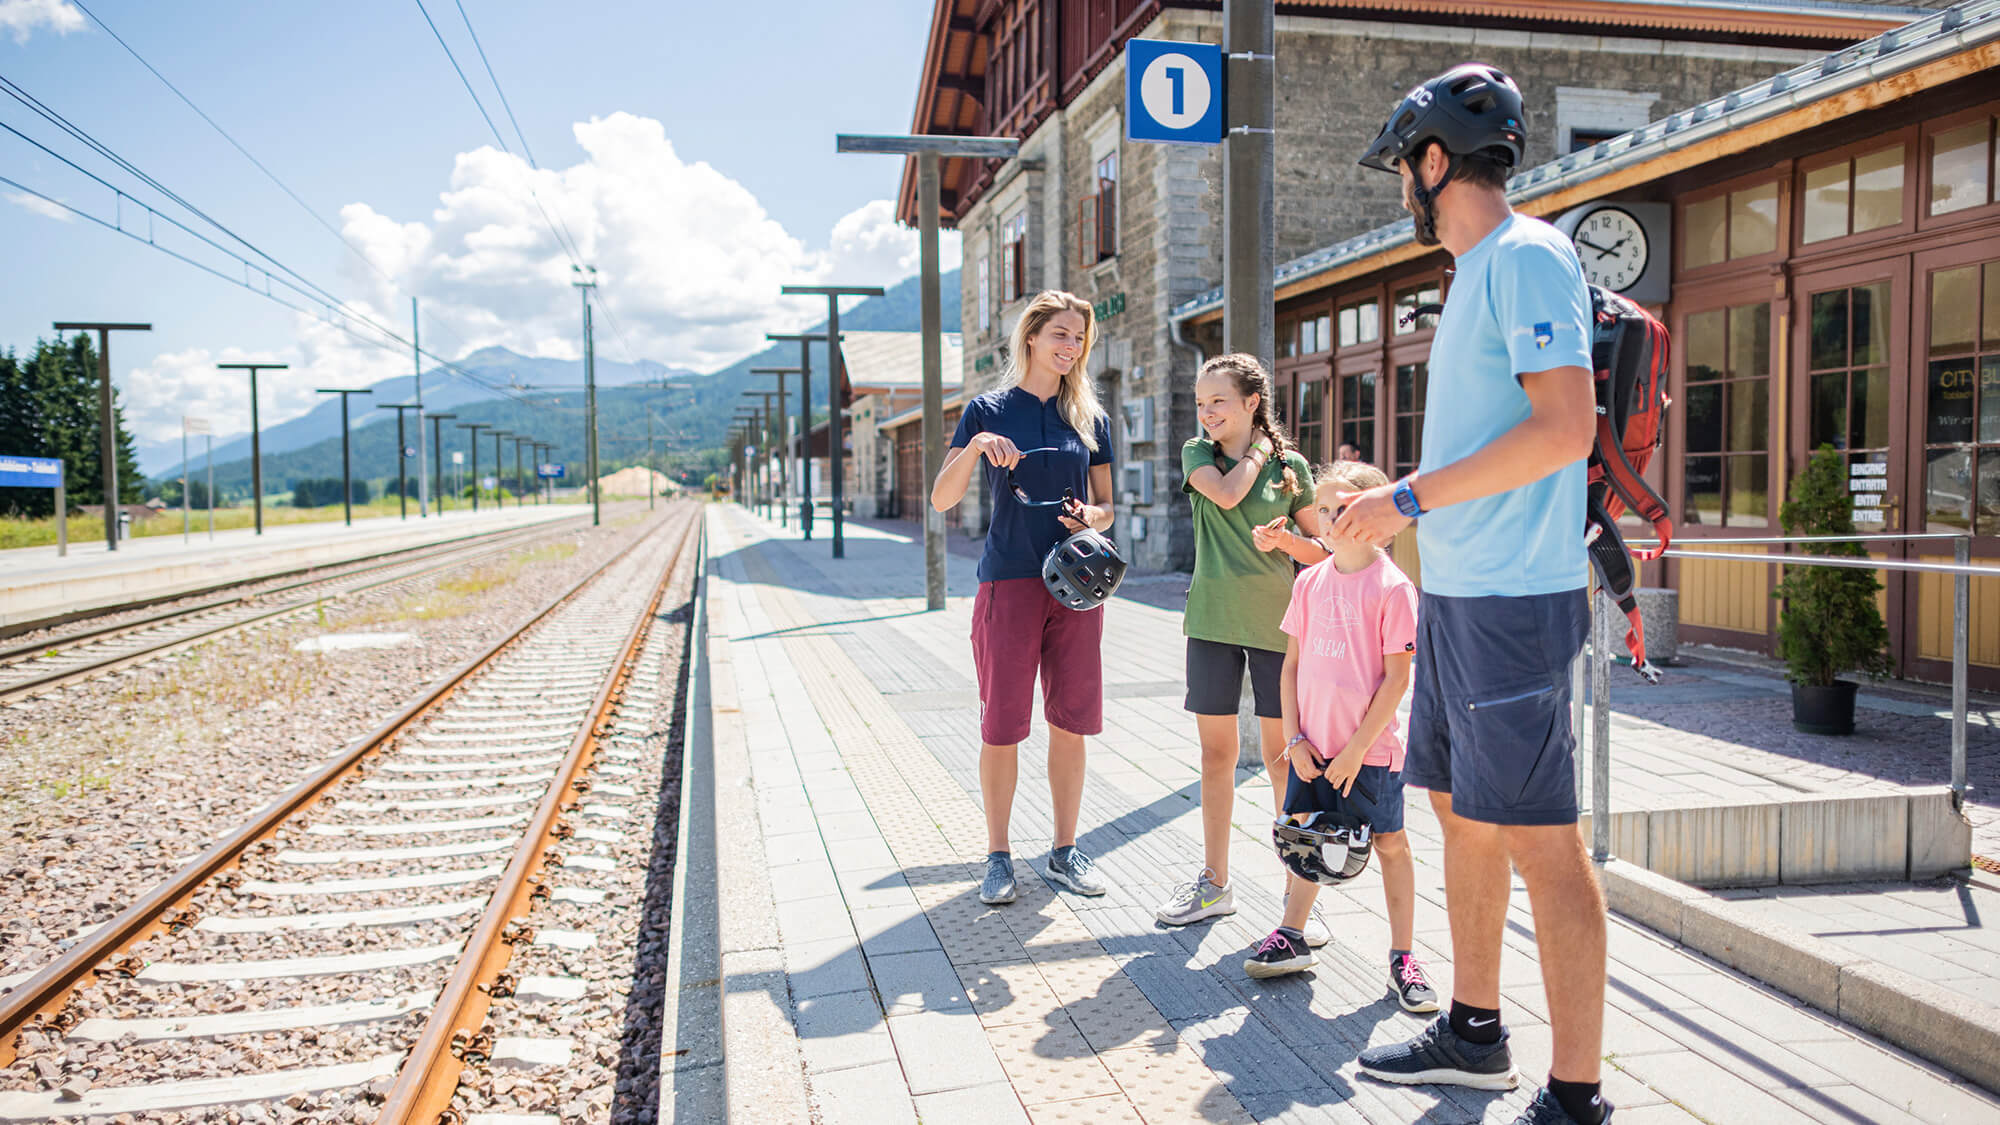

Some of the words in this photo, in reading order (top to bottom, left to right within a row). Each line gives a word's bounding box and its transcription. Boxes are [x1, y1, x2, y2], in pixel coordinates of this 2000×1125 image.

[1166, 67, 1184, 115] 1
[1591, 220, 1597, 231] 11
[1602, 216, 1611, 228] 12
[1618, 220, 1622, 231] 1
[1580, 232, 1589, 241] 10
[1627, 230, 1633, 241] 2
[1632, 246, 1639, 258] 3
[1627, 262, 1634, 272] 4
[1592, 272, 1597, 283] 7
[1604, 276, 1610, 287] 6
[1618, 272, 1624, 283] 5
